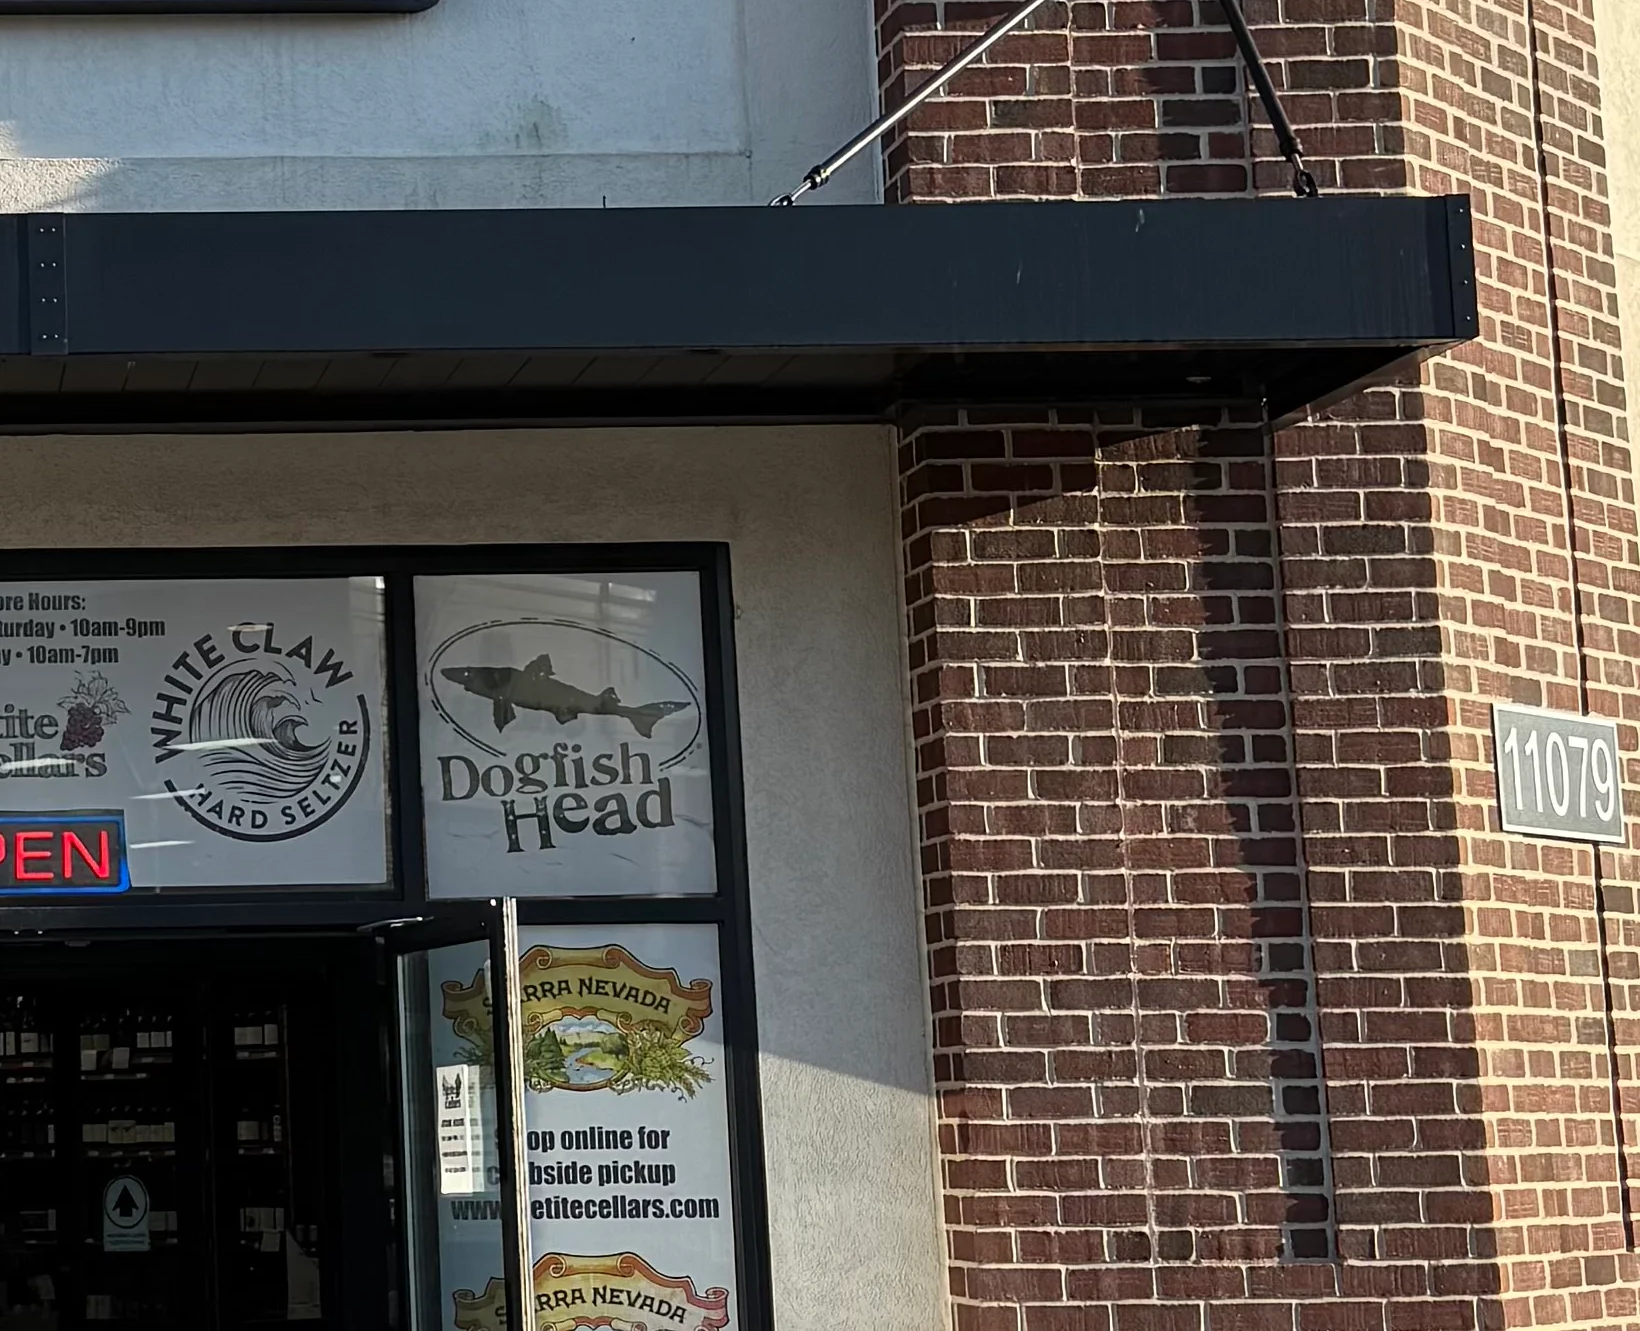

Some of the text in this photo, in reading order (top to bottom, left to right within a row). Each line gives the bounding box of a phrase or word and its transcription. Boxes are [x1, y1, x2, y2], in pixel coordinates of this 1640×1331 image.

[28, 592, 87, 611] Hours:
[70, 617, 166, 639] 10am-9pm
[27, 645, 120, 665] 10am-7pm
[150, 621, 354, 764] WHITE CLAW
[189, 719, 358, 829] HARD SELTZER
[437, 742, 655, 801] Dogfish
[1504, 727, 1616, 822] 11079
[500, 777, 676, 854] Head
[578, 975, 672, 1015] NEVADA
[560, 1126, 633, 1151] online
[637, 1125, 671, 1150] for
[598, 1160, 676, 1187] pickup
[591, 1284, 688, 1324] NEVADA
